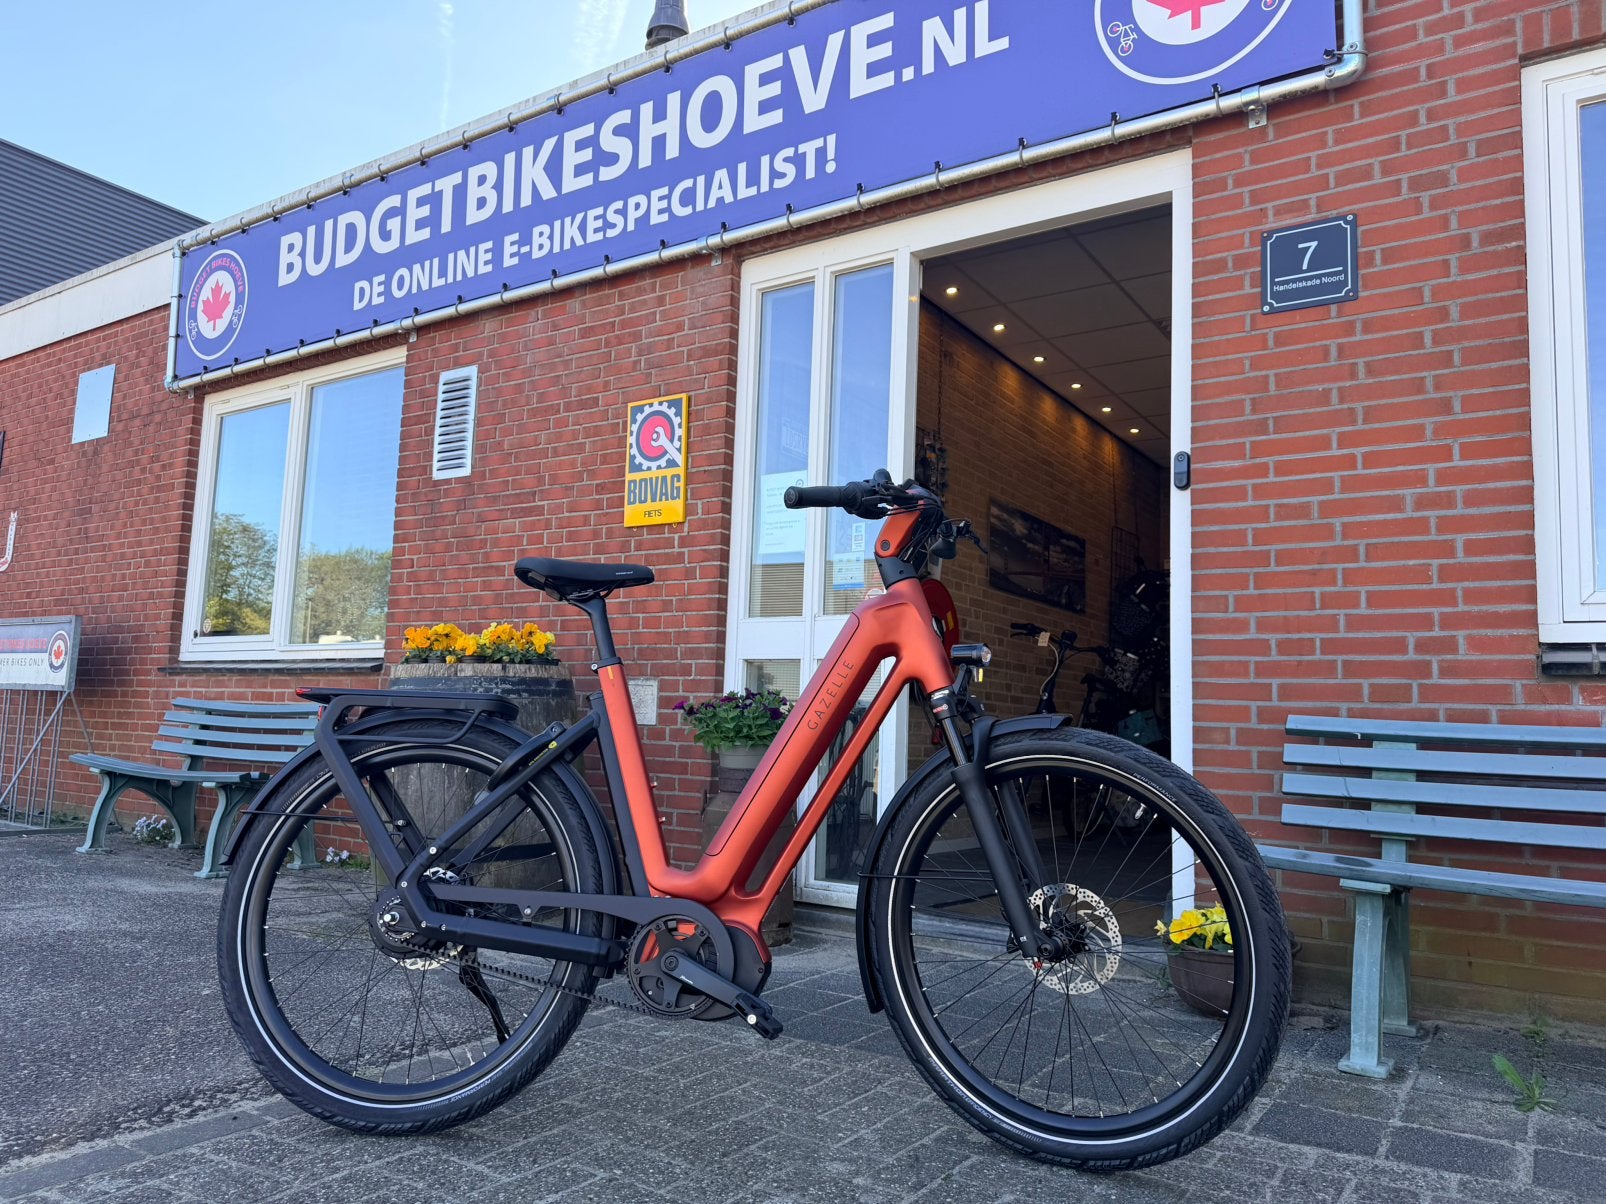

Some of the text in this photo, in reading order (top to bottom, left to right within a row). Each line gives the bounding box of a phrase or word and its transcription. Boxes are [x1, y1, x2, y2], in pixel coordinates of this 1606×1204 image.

[277, 0, 1010, 287] BUDGETBIKESHOEVE.NL
[353, 133, 837, 311] DE ONLINE E-BIKESPECIALIST!
[1297, 240, 1319, 270] 7
[1273, 274, 1345, 291] Handelskade Noord
[627, 473, 682, 506] BOVAG
[643, 509, 663, 518] FIETS
[11, 658, 27, 667] BIKES
[28, 658, 45, 667] ONLY
[807, 660, 855, 731] GAZELLE
